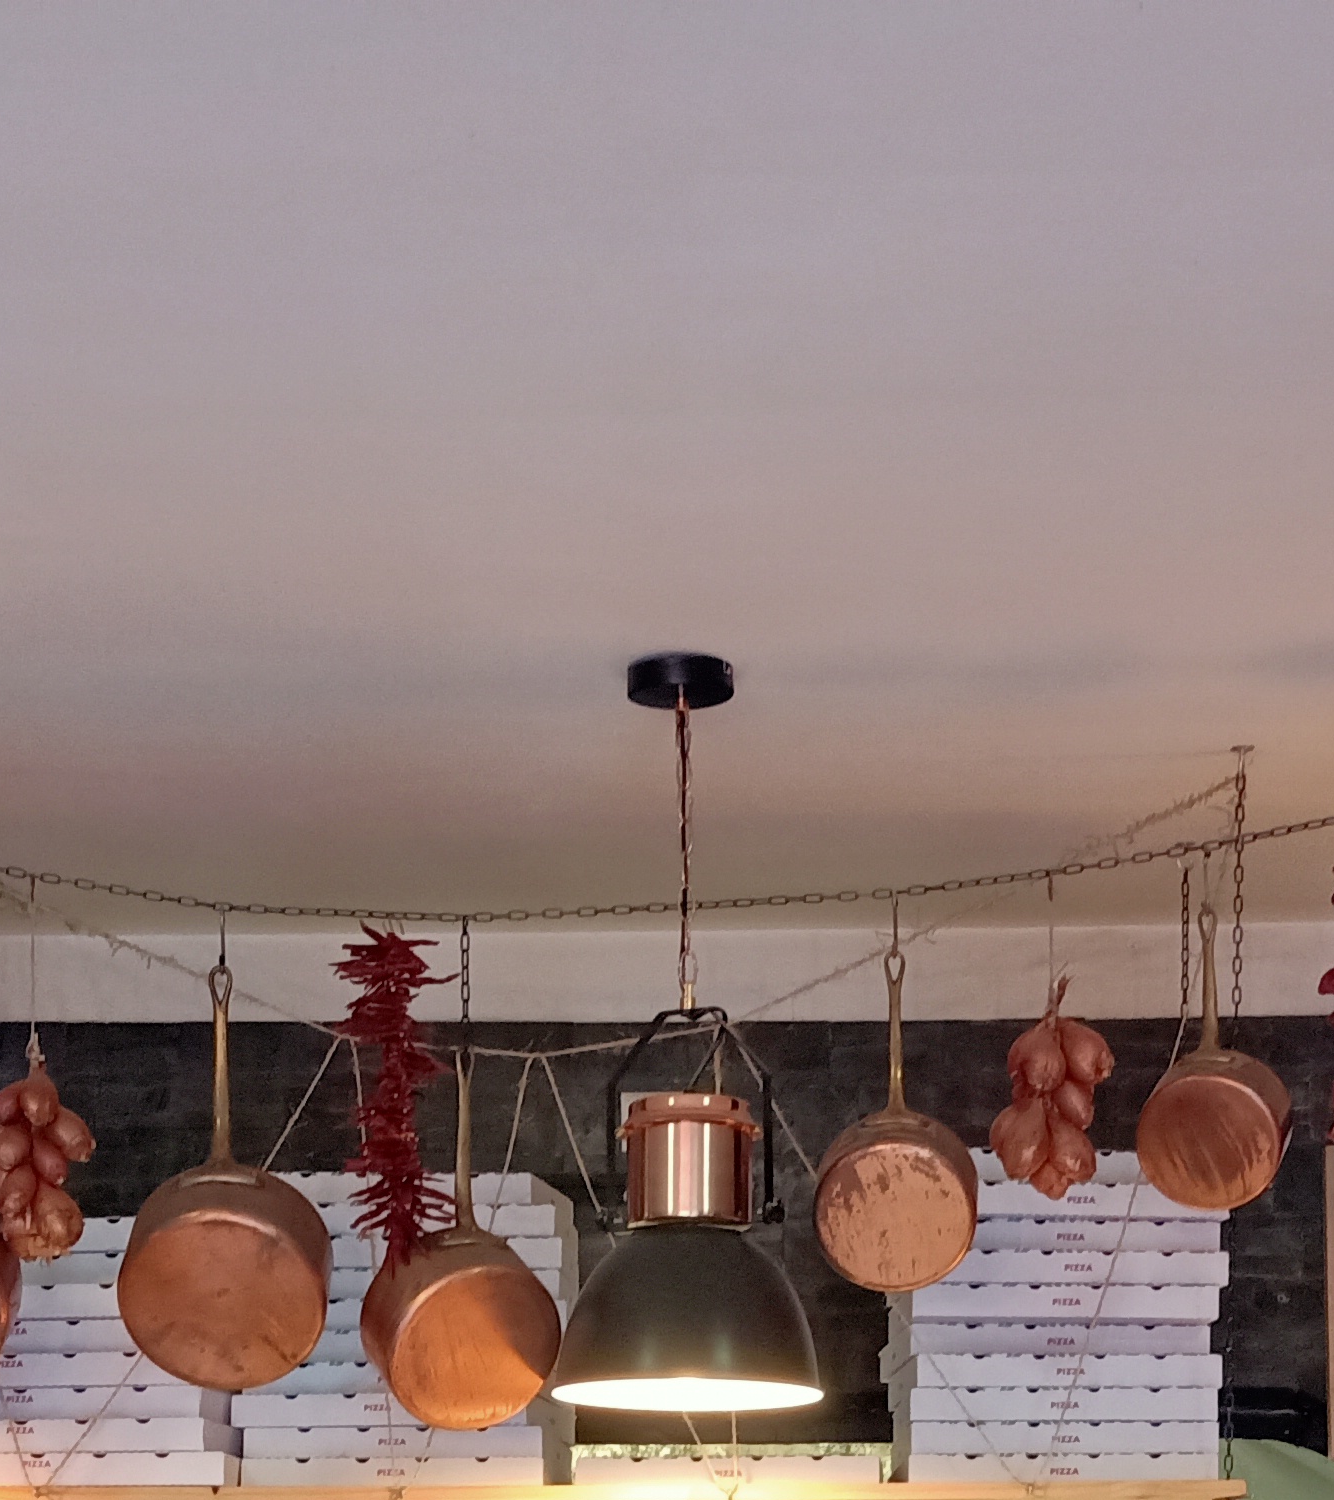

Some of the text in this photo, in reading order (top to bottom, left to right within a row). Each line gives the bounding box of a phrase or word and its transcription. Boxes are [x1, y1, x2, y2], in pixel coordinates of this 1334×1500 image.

[1067, 1195, 1096, 1204] PIZZA
[1056, 1232, 1085, 1241] PIZZA
[1064, 1263, 1093, 1272] PIZZA
[1052, 1298, 1081, 1306] PIZZA
[1047, 1337, 1075, 1345] PIZZA
[1056, 1367, 1085, 1375] PIZZA
[6, 1395, 34, 1403] PIZZA
[378, 1438, 406, 1446] PIZZA
[1051, 1435, 1080, 1443] PIZZA
[22, 1460, 51, 1468] PIZZA
[1050, 1467, 1079, 1475] PIZZA
